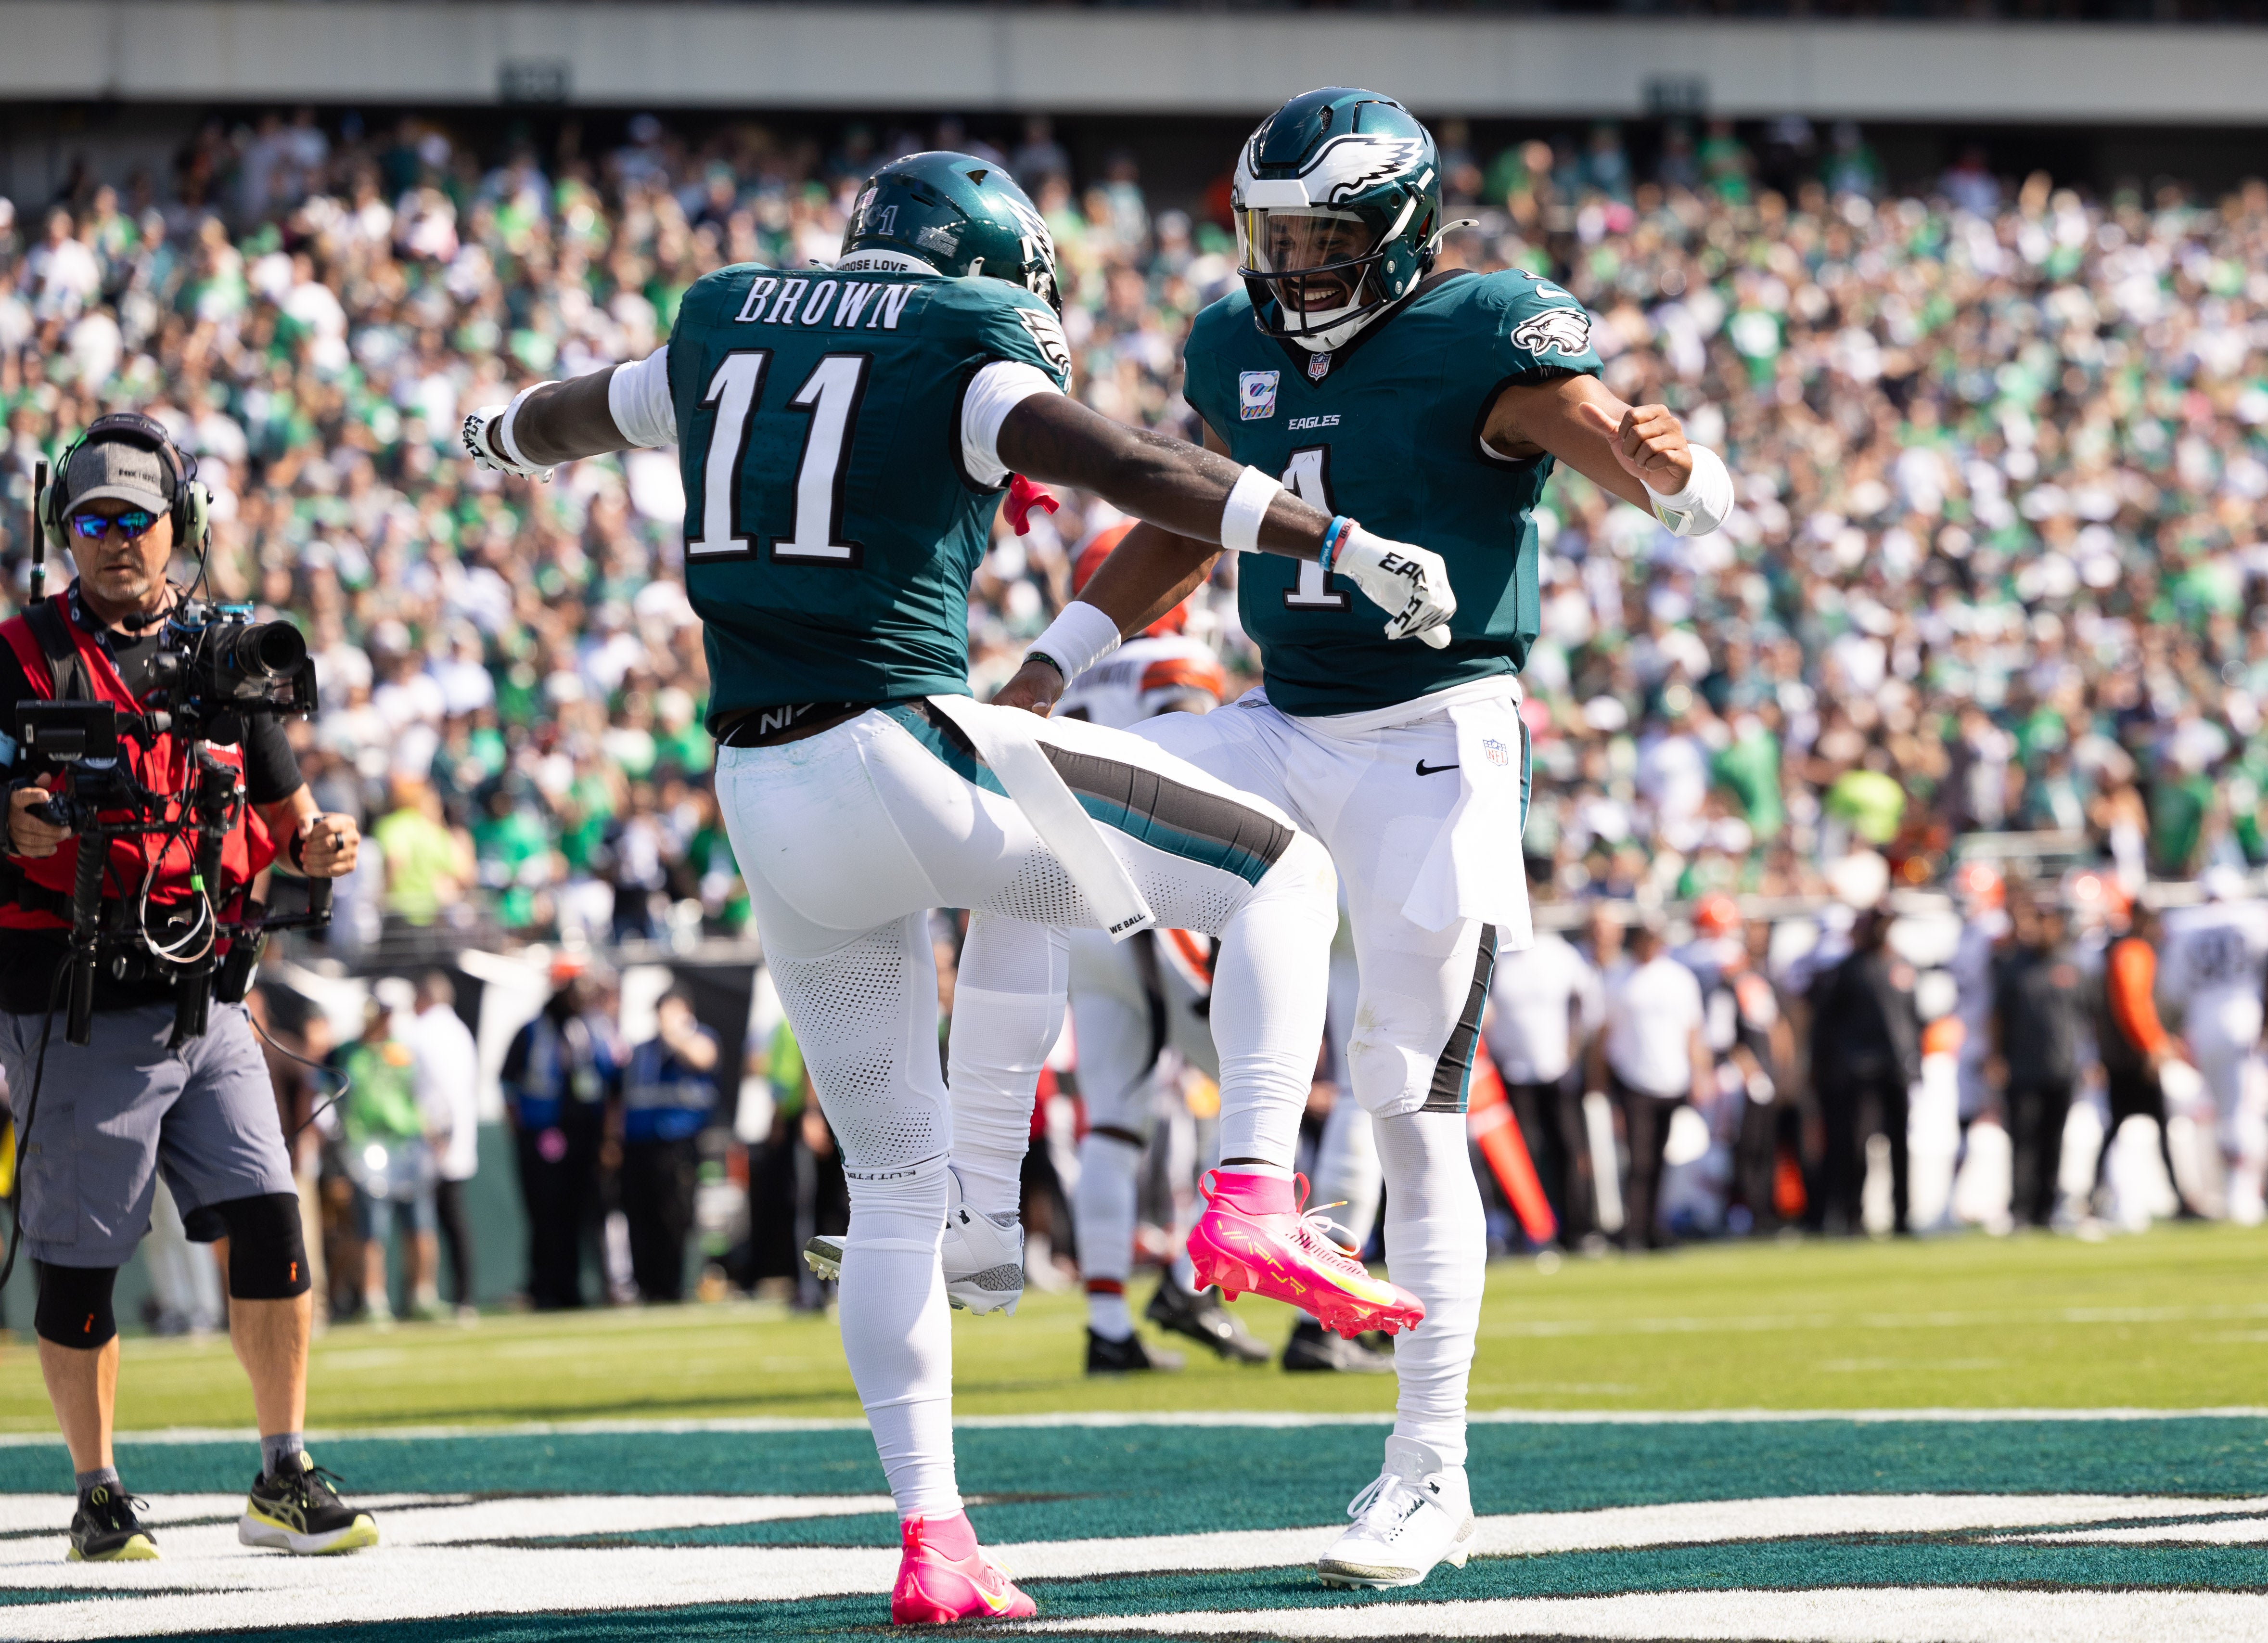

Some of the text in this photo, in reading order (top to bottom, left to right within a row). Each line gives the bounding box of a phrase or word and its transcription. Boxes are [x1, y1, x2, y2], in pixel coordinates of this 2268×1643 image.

[855, 205, 898, 236] 11
[873, 259, 908, 271] LOVE
[734, 276, 921, 330] BROWN
[1310, 363, 1325, 375] NFL
[1242, 374, 1275, 407] C
[1288, 414, 1342, 430] EAGLES
[686, 348, 874, 568] 11
[1278, 443, 1353, 613] 1
[1487, 748, 1507, 763] NFL
[1109, 914, 1145, 934] WE BALL.
